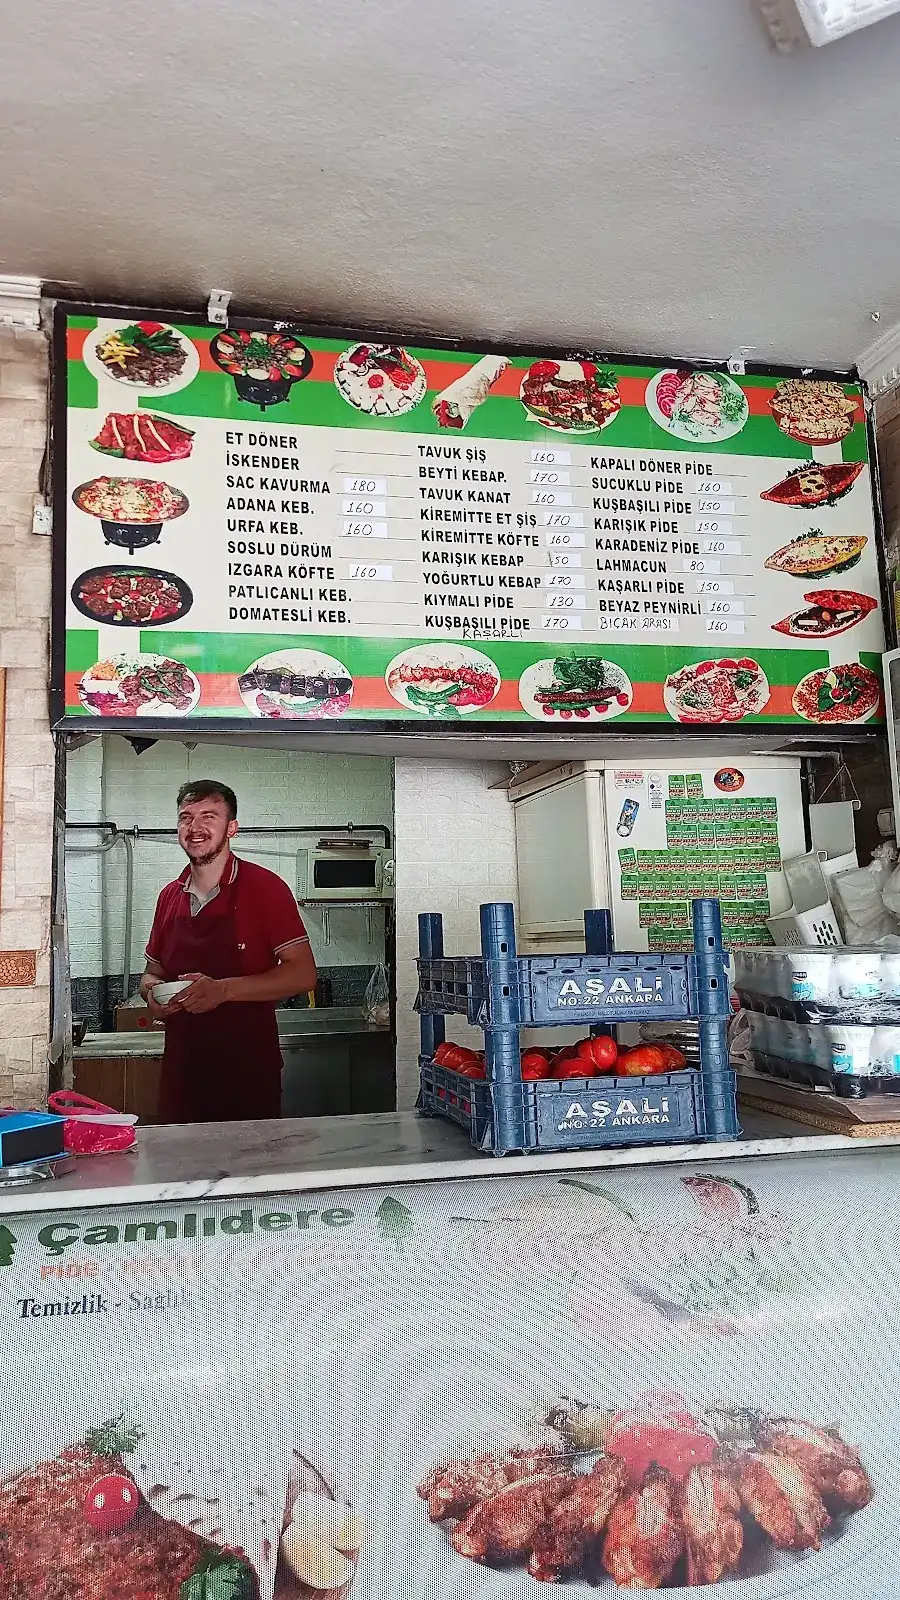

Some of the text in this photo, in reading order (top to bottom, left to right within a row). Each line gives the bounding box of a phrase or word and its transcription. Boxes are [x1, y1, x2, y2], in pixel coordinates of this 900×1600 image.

[226, 432, 298, 449] ET DÖNER
[226, 451, 299, 470] İSKENDER
[418, 446, 486, 463] TAVUK ŞİŞ
[534, 453, 554, 462] 160
[591, 457, 712, 475] KAPALI DÖNER PİDE
[419, 466, 506, 482] BEYTİ KEBAP.
[533, 472, 558, 483] 170
[227, 476, 330, 493] SAC KAVURMA
[351, 480, 376, 492] 180
[592, 477, 683, 493] SUCUKLU PİDE
[698, 483, 721, 492] 160
[419, 488, 510, 504] TAVUK KANAT
[535, 493, 555, 503] 160
[227, 498, 314, 514] ADANA KEB.
[347, 502, 373, 514] 160
[593, 498, 692, 514] KUŞBAŞILI PİDE
[700, 501, 720, 510] 150
[421, 506, 537, 528] KİREMİTTE ET ŞİŞ
[546, 515, 570, 525] 170
[228, 519, 303, 535] URFA KEB.
[346, 524, 372, 535] 160
[594, 518, 678, 534] KARIŞIK PİDE
[697, 522, 718, 531] 150
[421, 528, 539, 546] KİREMİTTE KÖFTE
[550, 535, 570, 544] 160
[228, 541, 332, 558] SOSLU DÜRÜM
[595, 538, 700, 554] KARADENİZ PİDE
[422, 551, 523, 567] KARIŞIK KEBAP
[597, 559, 666, 573] LAHMACUN
[690, 561, 704, 570] 80
[228, 563, 334, 579] IZGARA KÖFTE
[352, 567, 377, 577] 160
[423, 571, 541, 588] YOĞURTLU KEBAP
[549, 576, 571, 585] 170
[598, 579, 684, 594] KAŞARLI PİDE
[229, 585, 351, 602] PATLICANLI KEB.
[700, 583, 719, 592] 150
[424, 594, 514, 608] KIYMALI PİDE
[550, 597, 573, 606] 130
[599, 600, 701, 614] BEYAZ PEYNİRLİ
[710, 603, 730, 612] 160
[229, 607, 351, 623] DOMATESLİ KEB.
[425, 615, 530, 630] KUŞBAŞILI PİDE
[544, 619, 568, 628] 170
[642, 618, 671, 629] ARASI
[708, 622, 727, 631] 160
[557, 994, 663, 1006] NO:22 ANKARA
[612, 1115, 669, 1126] ANKARA
[38, 1207, 355, 1256] Çamlıdere
[18, 1293, 107, 1319] Temizlik
